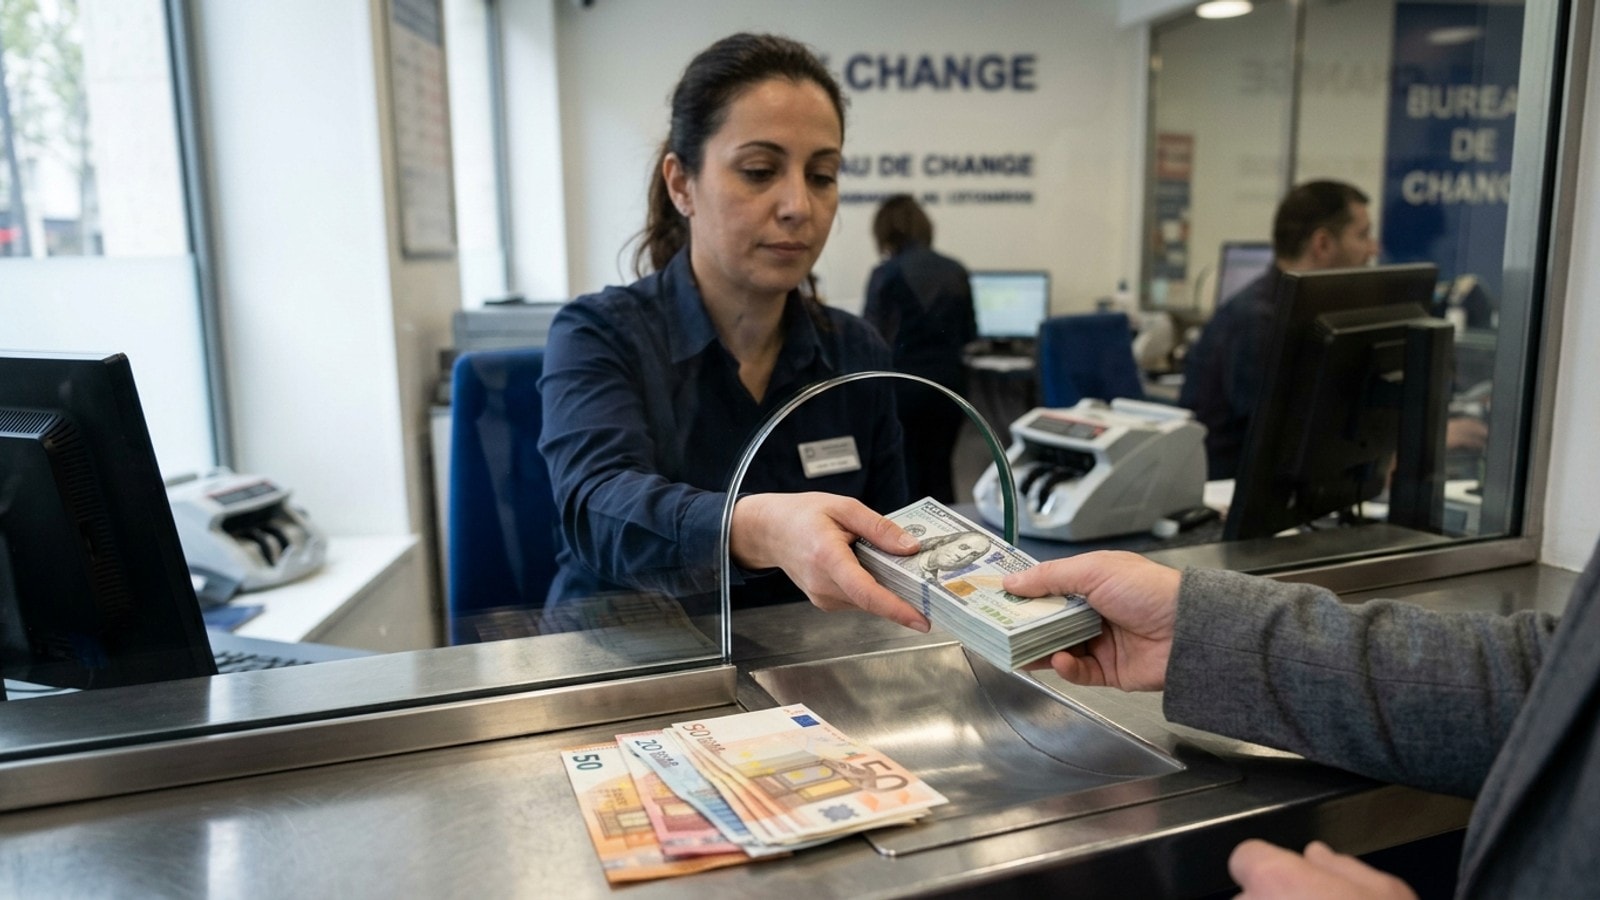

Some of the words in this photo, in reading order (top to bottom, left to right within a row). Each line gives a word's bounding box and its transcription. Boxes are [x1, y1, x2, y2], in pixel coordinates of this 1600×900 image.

[844, 53, 1037, 92] CHANGE
[1450, 127, 1498, 162] DE
[878, 154, 912, 177] DE
[922, 154, 1034, 177] CHANGE
[573, 754, 603, 771] 50
[860, 760, 909, 793] 50
